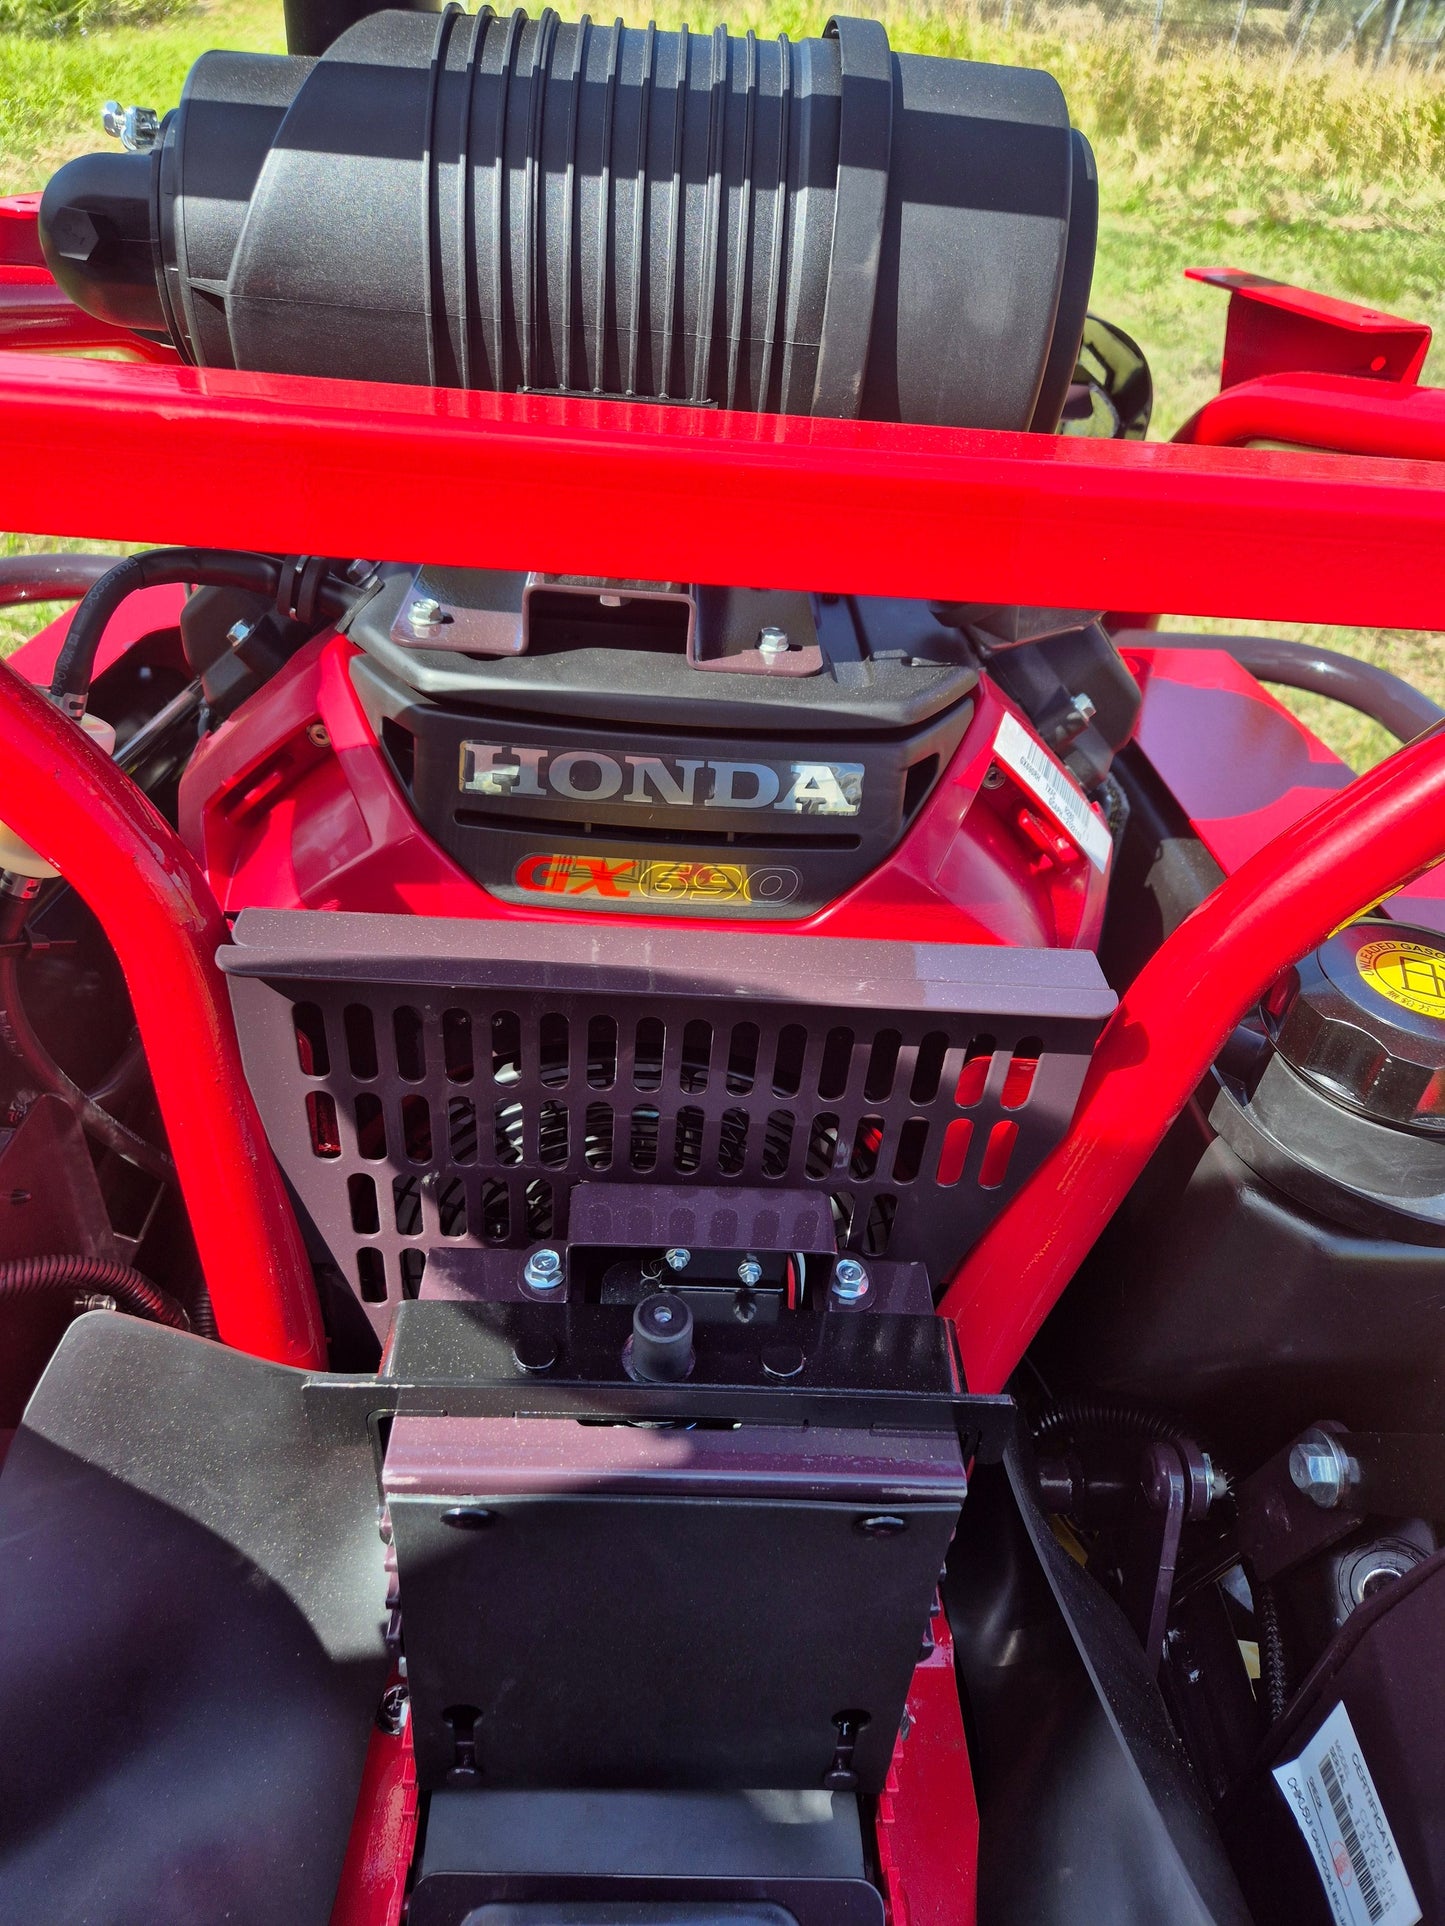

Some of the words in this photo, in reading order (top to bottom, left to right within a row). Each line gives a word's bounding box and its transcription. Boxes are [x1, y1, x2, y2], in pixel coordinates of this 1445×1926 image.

[464, 744, 859, 813] HONDA
[515, 854, 800, 906] GX690
[1360, 942, 1397, 977] UNLEADED
[1286, 1776, 1313, 1825] CHIKUSUI
[1352, 1752, 1396, 1864] CERTIFICATE
